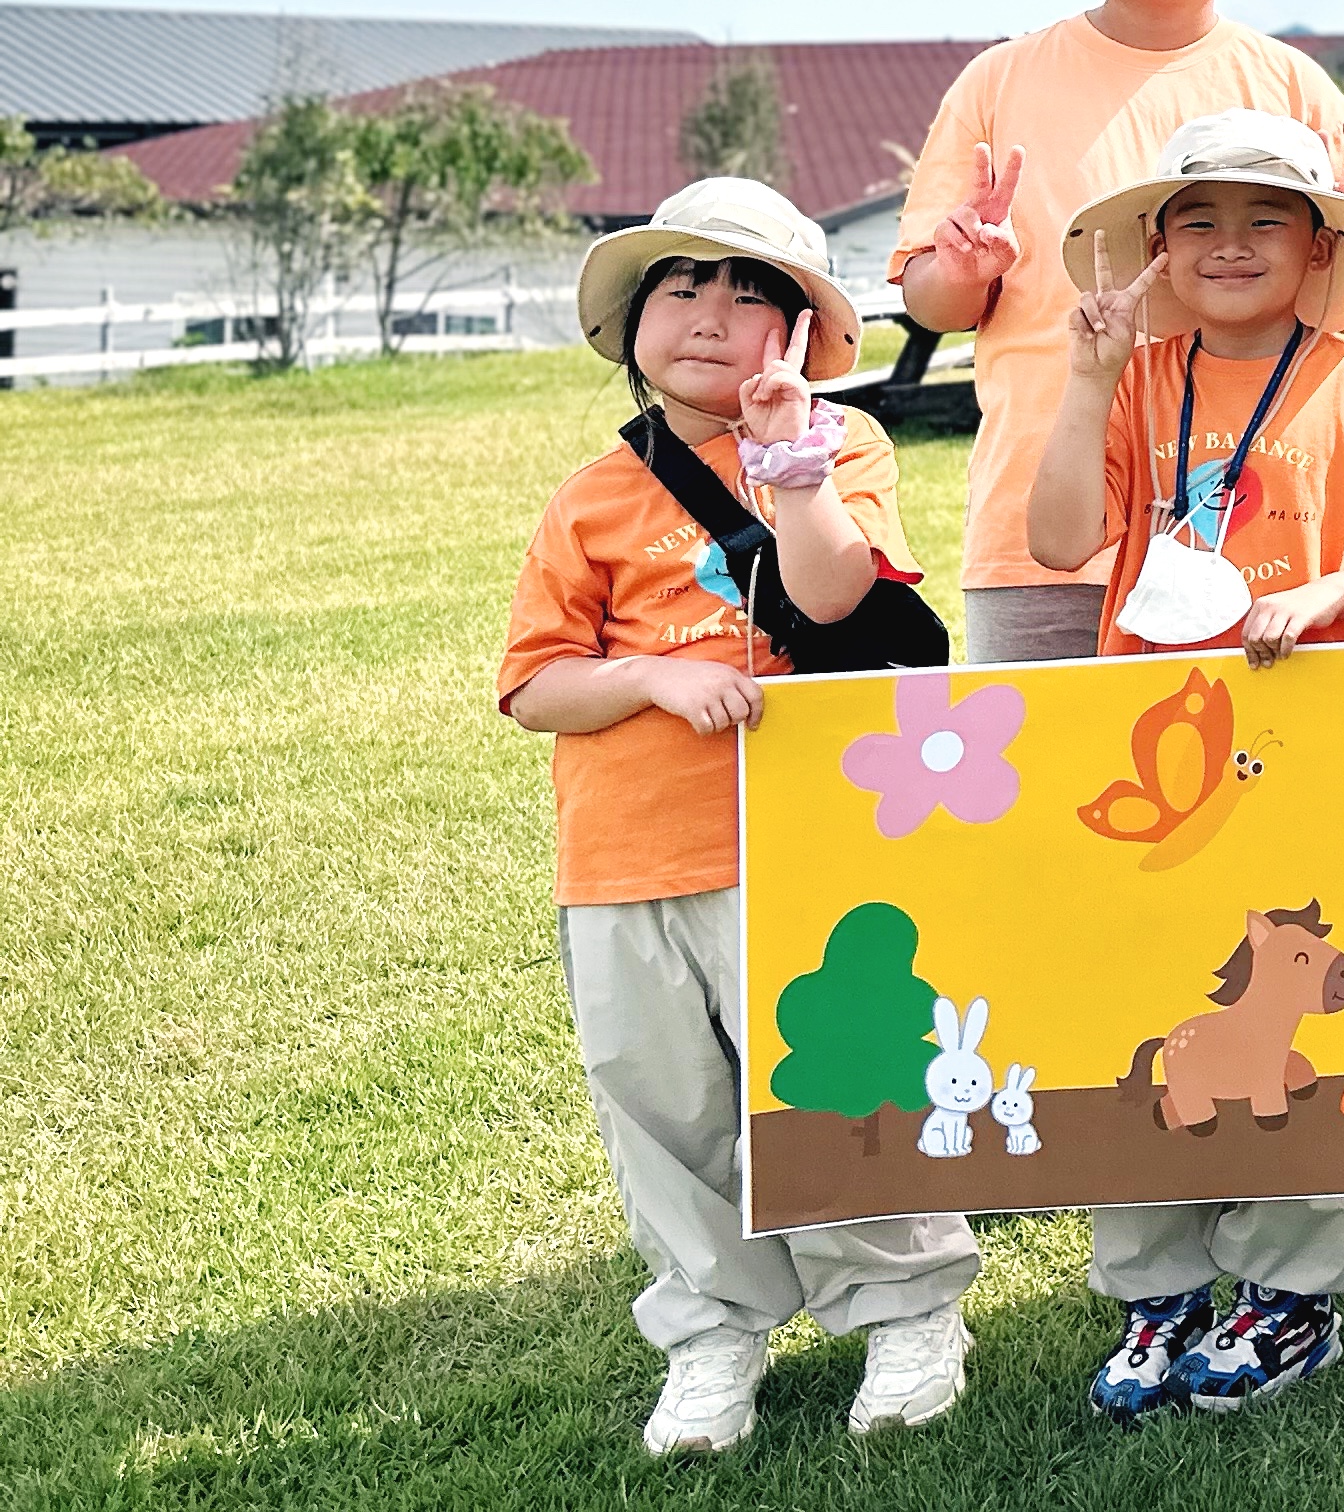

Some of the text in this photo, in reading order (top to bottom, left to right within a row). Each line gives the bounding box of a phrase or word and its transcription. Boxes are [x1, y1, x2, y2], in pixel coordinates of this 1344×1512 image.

[1205, 431, 1315, 472] BAANCE
[1267, 509, 1286, 521] MA
[644, 522, 698, 561] NEW
